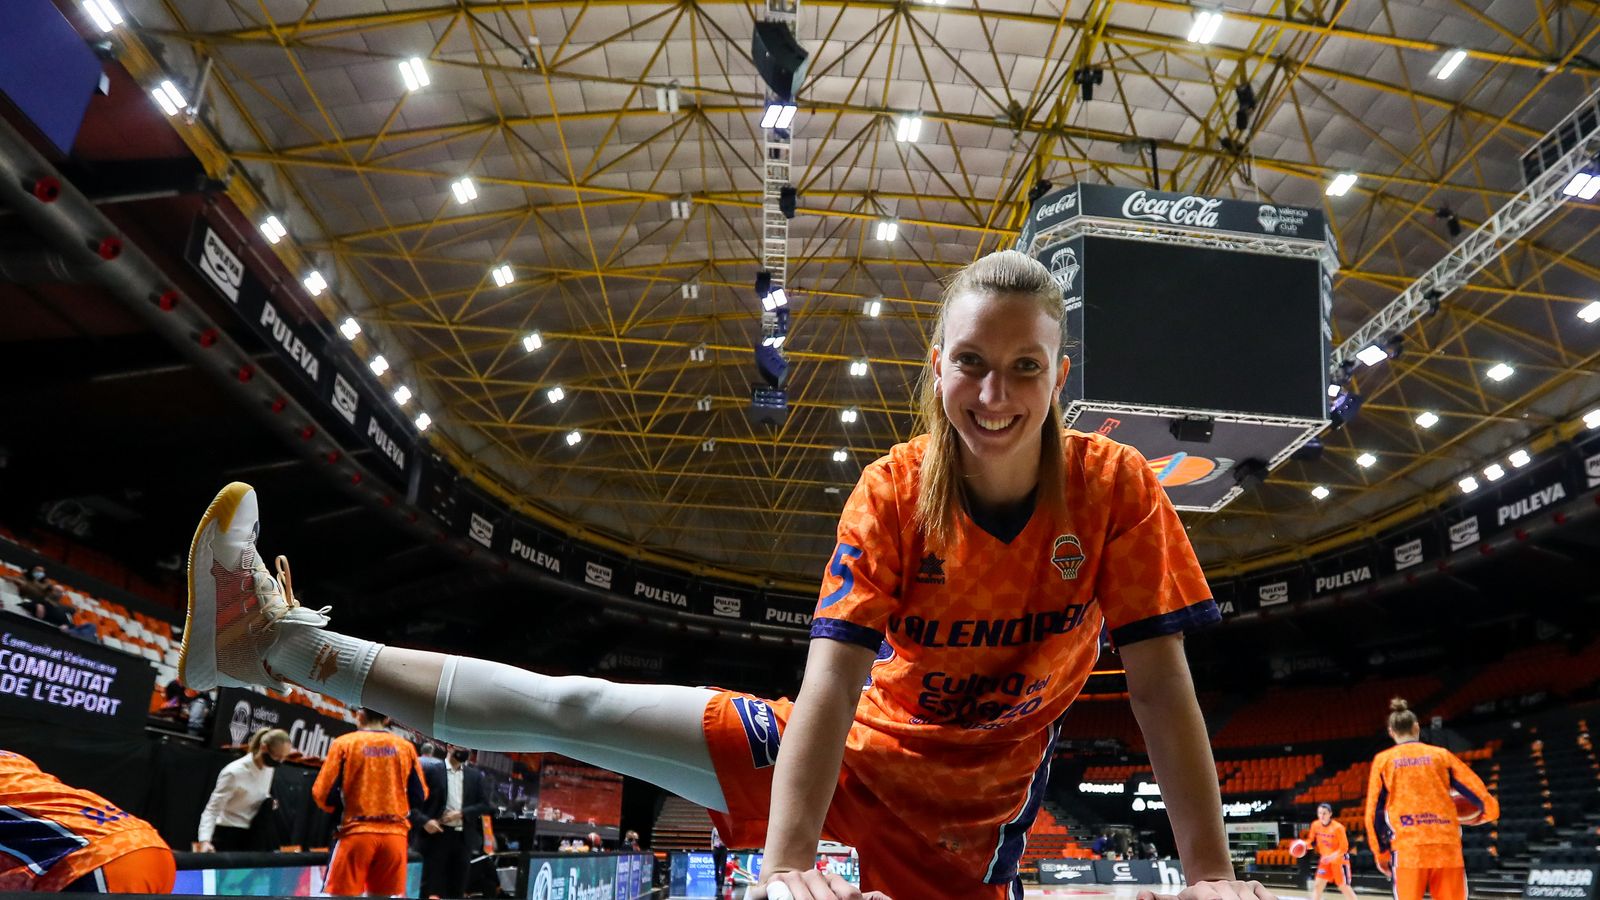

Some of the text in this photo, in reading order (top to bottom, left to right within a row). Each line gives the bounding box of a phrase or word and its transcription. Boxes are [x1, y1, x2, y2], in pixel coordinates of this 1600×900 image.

[1122, 190, 1222, 227] Coca-Cola
[1279, 207, 1308, 217] valencia
[1280, 223, 1298, 231] club
[207, 236, 240, 278] PULEVA
[259, 300, 319, 382] PULEVA
[336, 380, 357, 405] PULEVA
[367, 415, 405, 471] PULEVA
[1497, 482, 1566, 527] PULEVA
[472, 515, 492, 534] PULEVA
[1452, 521, 1477, 535] PULEVA
[510, 538, 560, 573] PULEVA
[587, 565, 610, 576] PULEVA
[821, 543, 863, 608] 5
[1315, 566, 1372, 594] PULEVA
[634, 581, 687, 608] PULEVA
[715, 598, 739, 607] PULEVA
[1261, 585, 1286, 595] PULEVA
[765, 607, 812, 625] PULEV
[0, 649, 115, 694] COMUNITAT
[0, 673, 123, 716] DE L'ESPORT
[702, 856, 715, 864] GA
